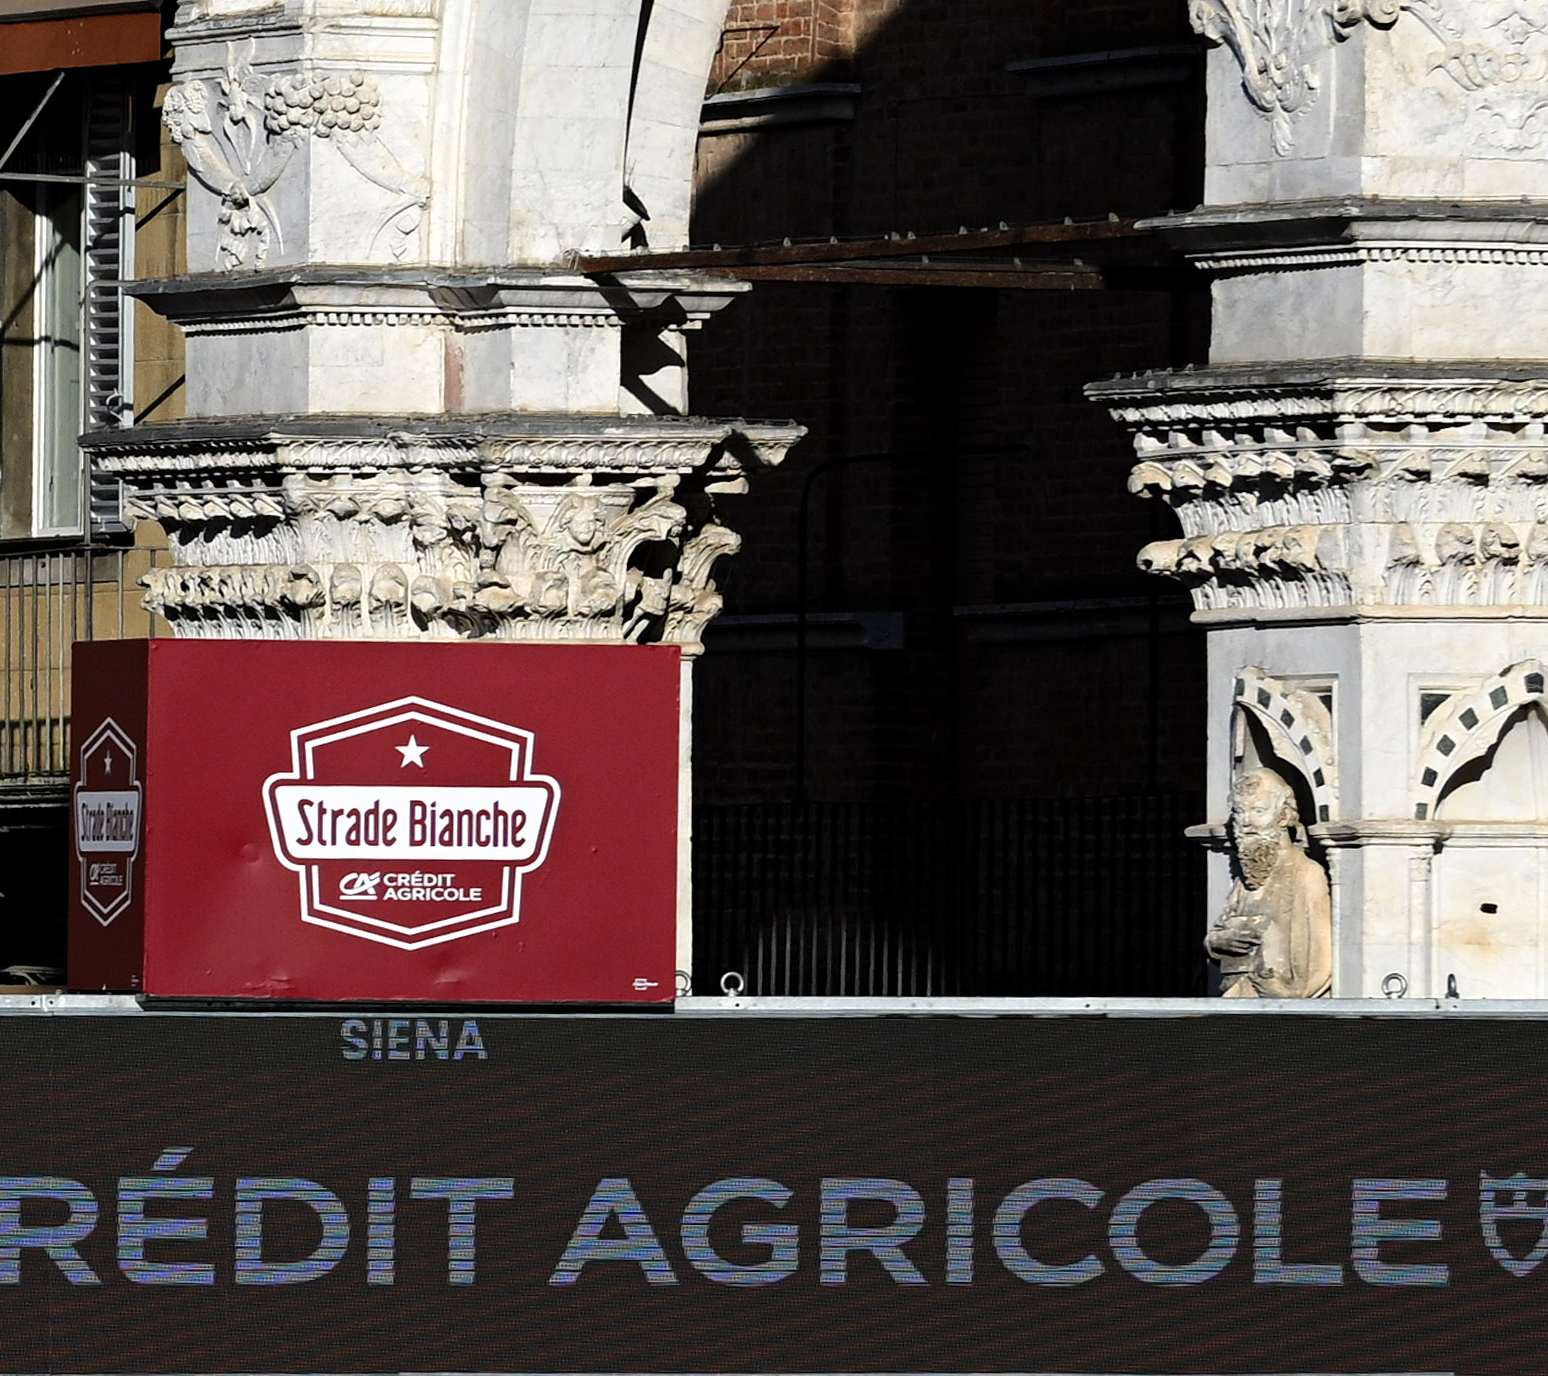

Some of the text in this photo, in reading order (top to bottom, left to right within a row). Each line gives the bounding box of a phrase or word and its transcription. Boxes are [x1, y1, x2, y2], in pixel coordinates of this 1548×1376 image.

[295, 798, 527, 848] Strade Bianche
[383, 870, 455, 887] CRÉDIT
[383, 887, 482, 901] AGRICOLE
[340, 1019, 488, 1061] SIENA
[549, 1176, 1452, 1286] AGRICOLE
